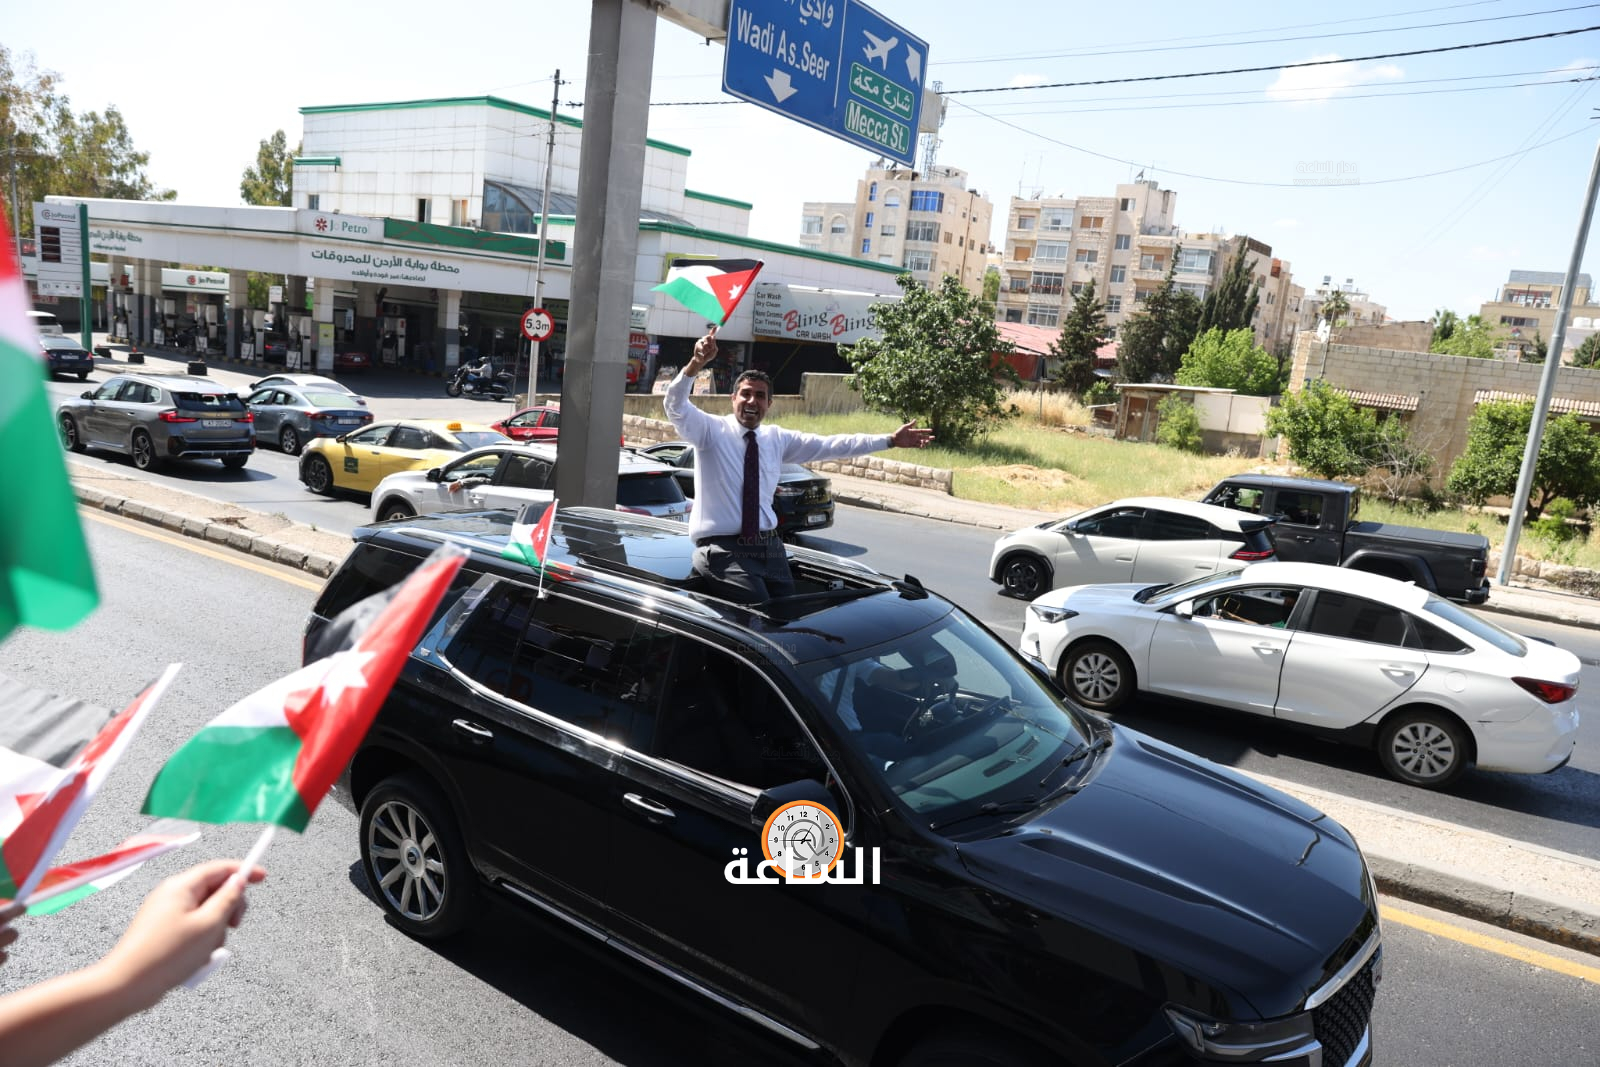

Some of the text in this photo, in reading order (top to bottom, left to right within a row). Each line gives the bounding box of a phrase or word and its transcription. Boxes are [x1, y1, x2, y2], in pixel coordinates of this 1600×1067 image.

[737, 7, 775, 56] Wadi
[853, 66, 911, 112] شارع مكة
[847, 102, 906, 152] Mecca St.
[311, 250, 460, 274] محطة بوابة الأردن للمحروقات
[525, 318, 550, 330] 5.3m
[783, 310, 876, 336] Bling Bling
[796, 330, 832, 340] CAR WASH
